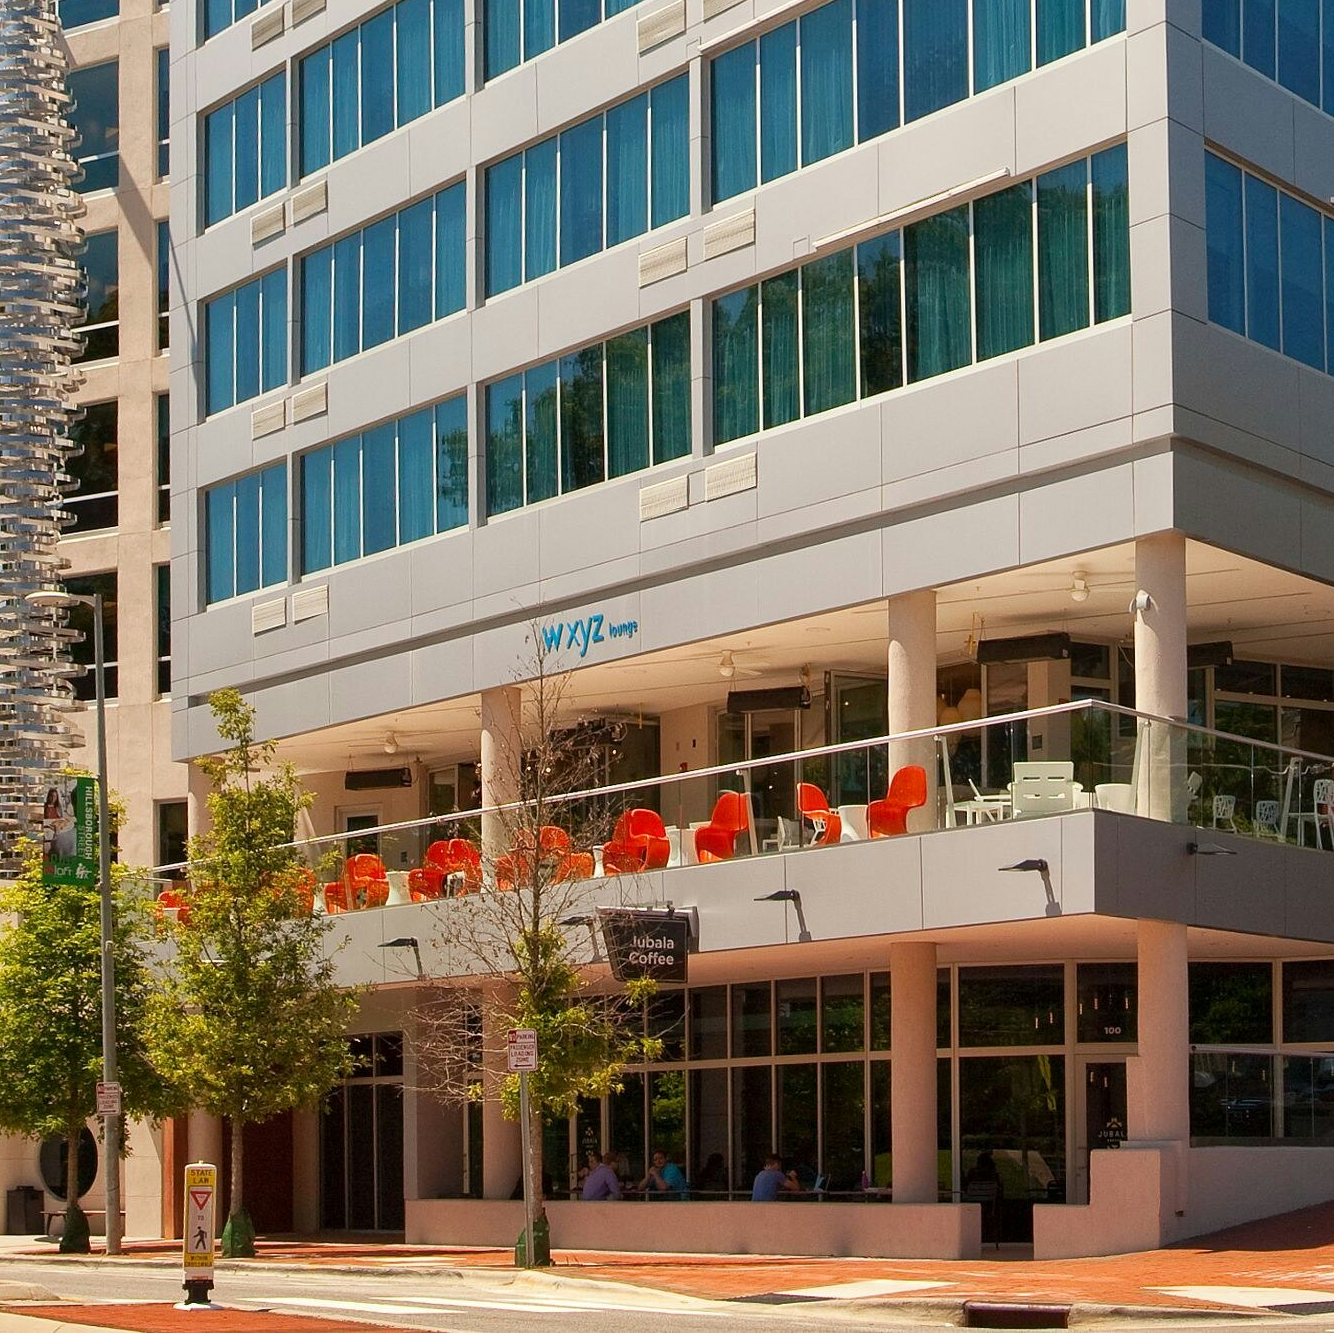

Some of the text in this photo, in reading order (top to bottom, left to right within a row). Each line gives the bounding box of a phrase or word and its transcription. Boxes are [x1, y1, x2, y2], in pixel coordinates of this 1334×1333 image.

[609, 620, 638, 639] lounge
[85, 786, 93, 860] HILLSBOROUGH
[77, 824, 85, 858] STREET
[630, 935, 674, 949] Jubala
[629, 951, 674, 965] Coffee
